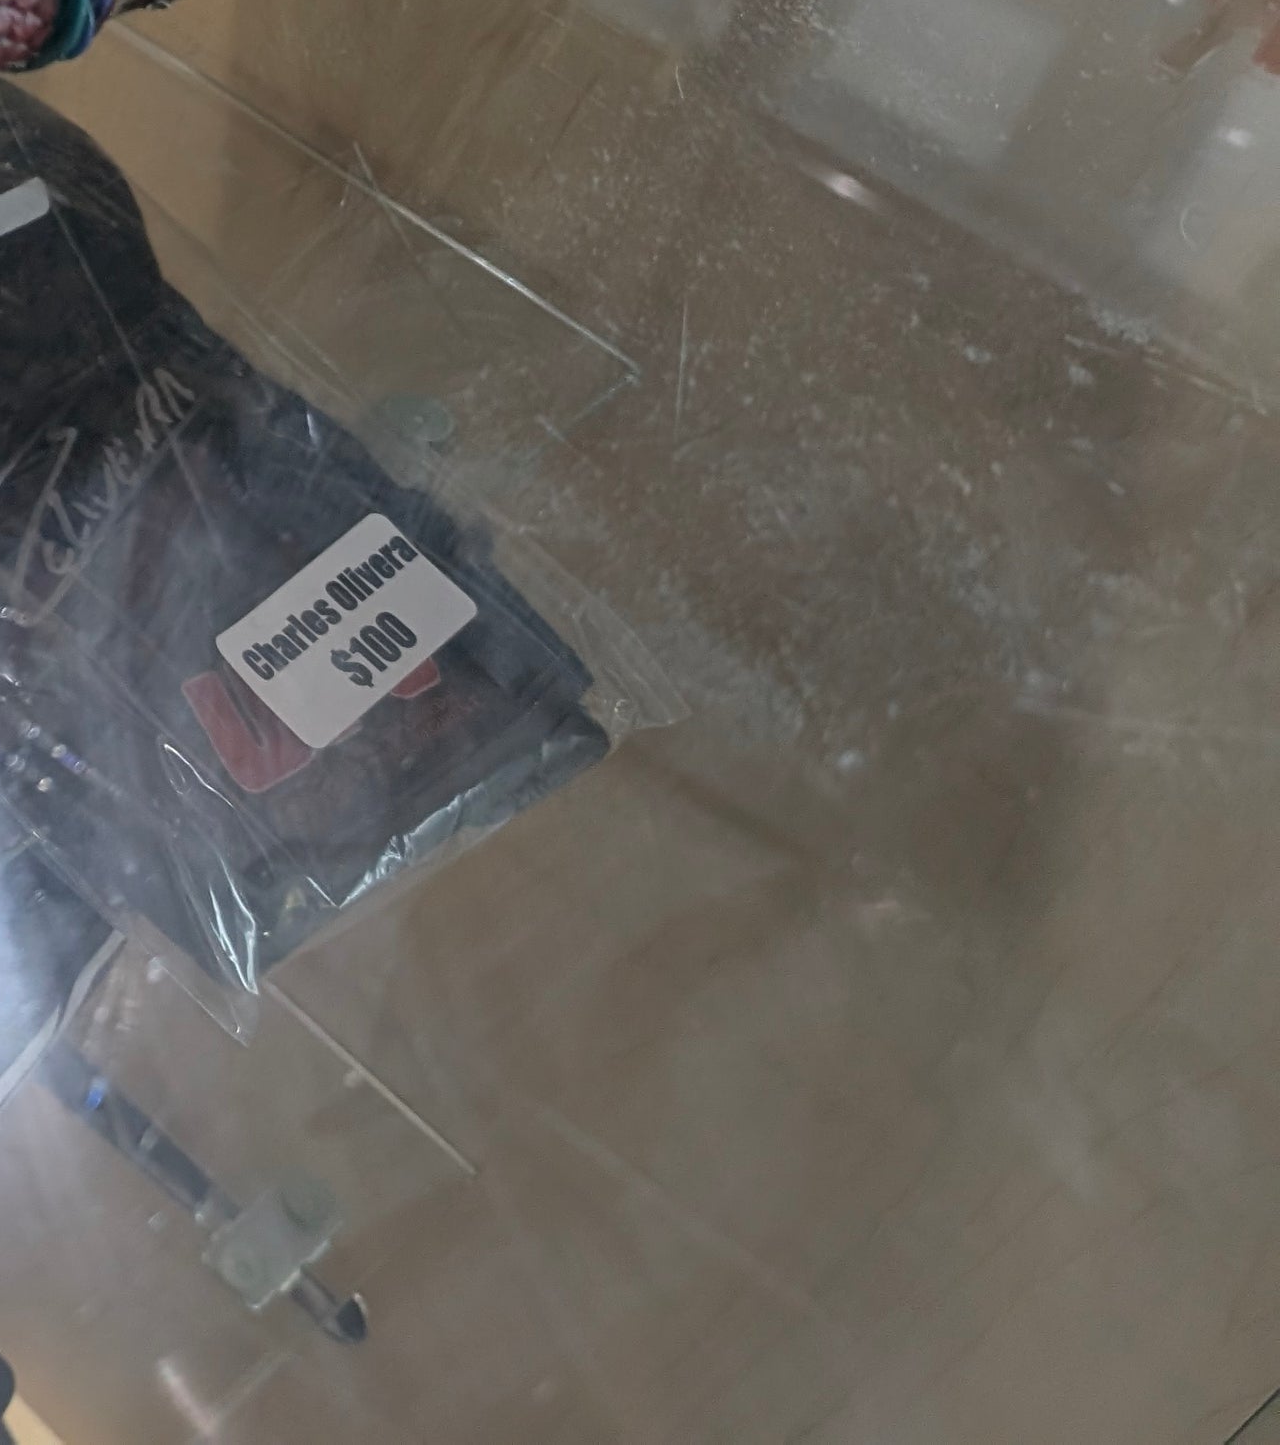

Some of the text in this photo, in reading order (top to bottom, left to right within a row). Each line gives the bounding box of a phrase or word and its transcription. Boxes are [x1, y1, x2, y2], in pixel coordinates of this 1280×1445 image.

[241, 535, 419, 681] Charles Olivera
[329, 611, 418, 689] $100
